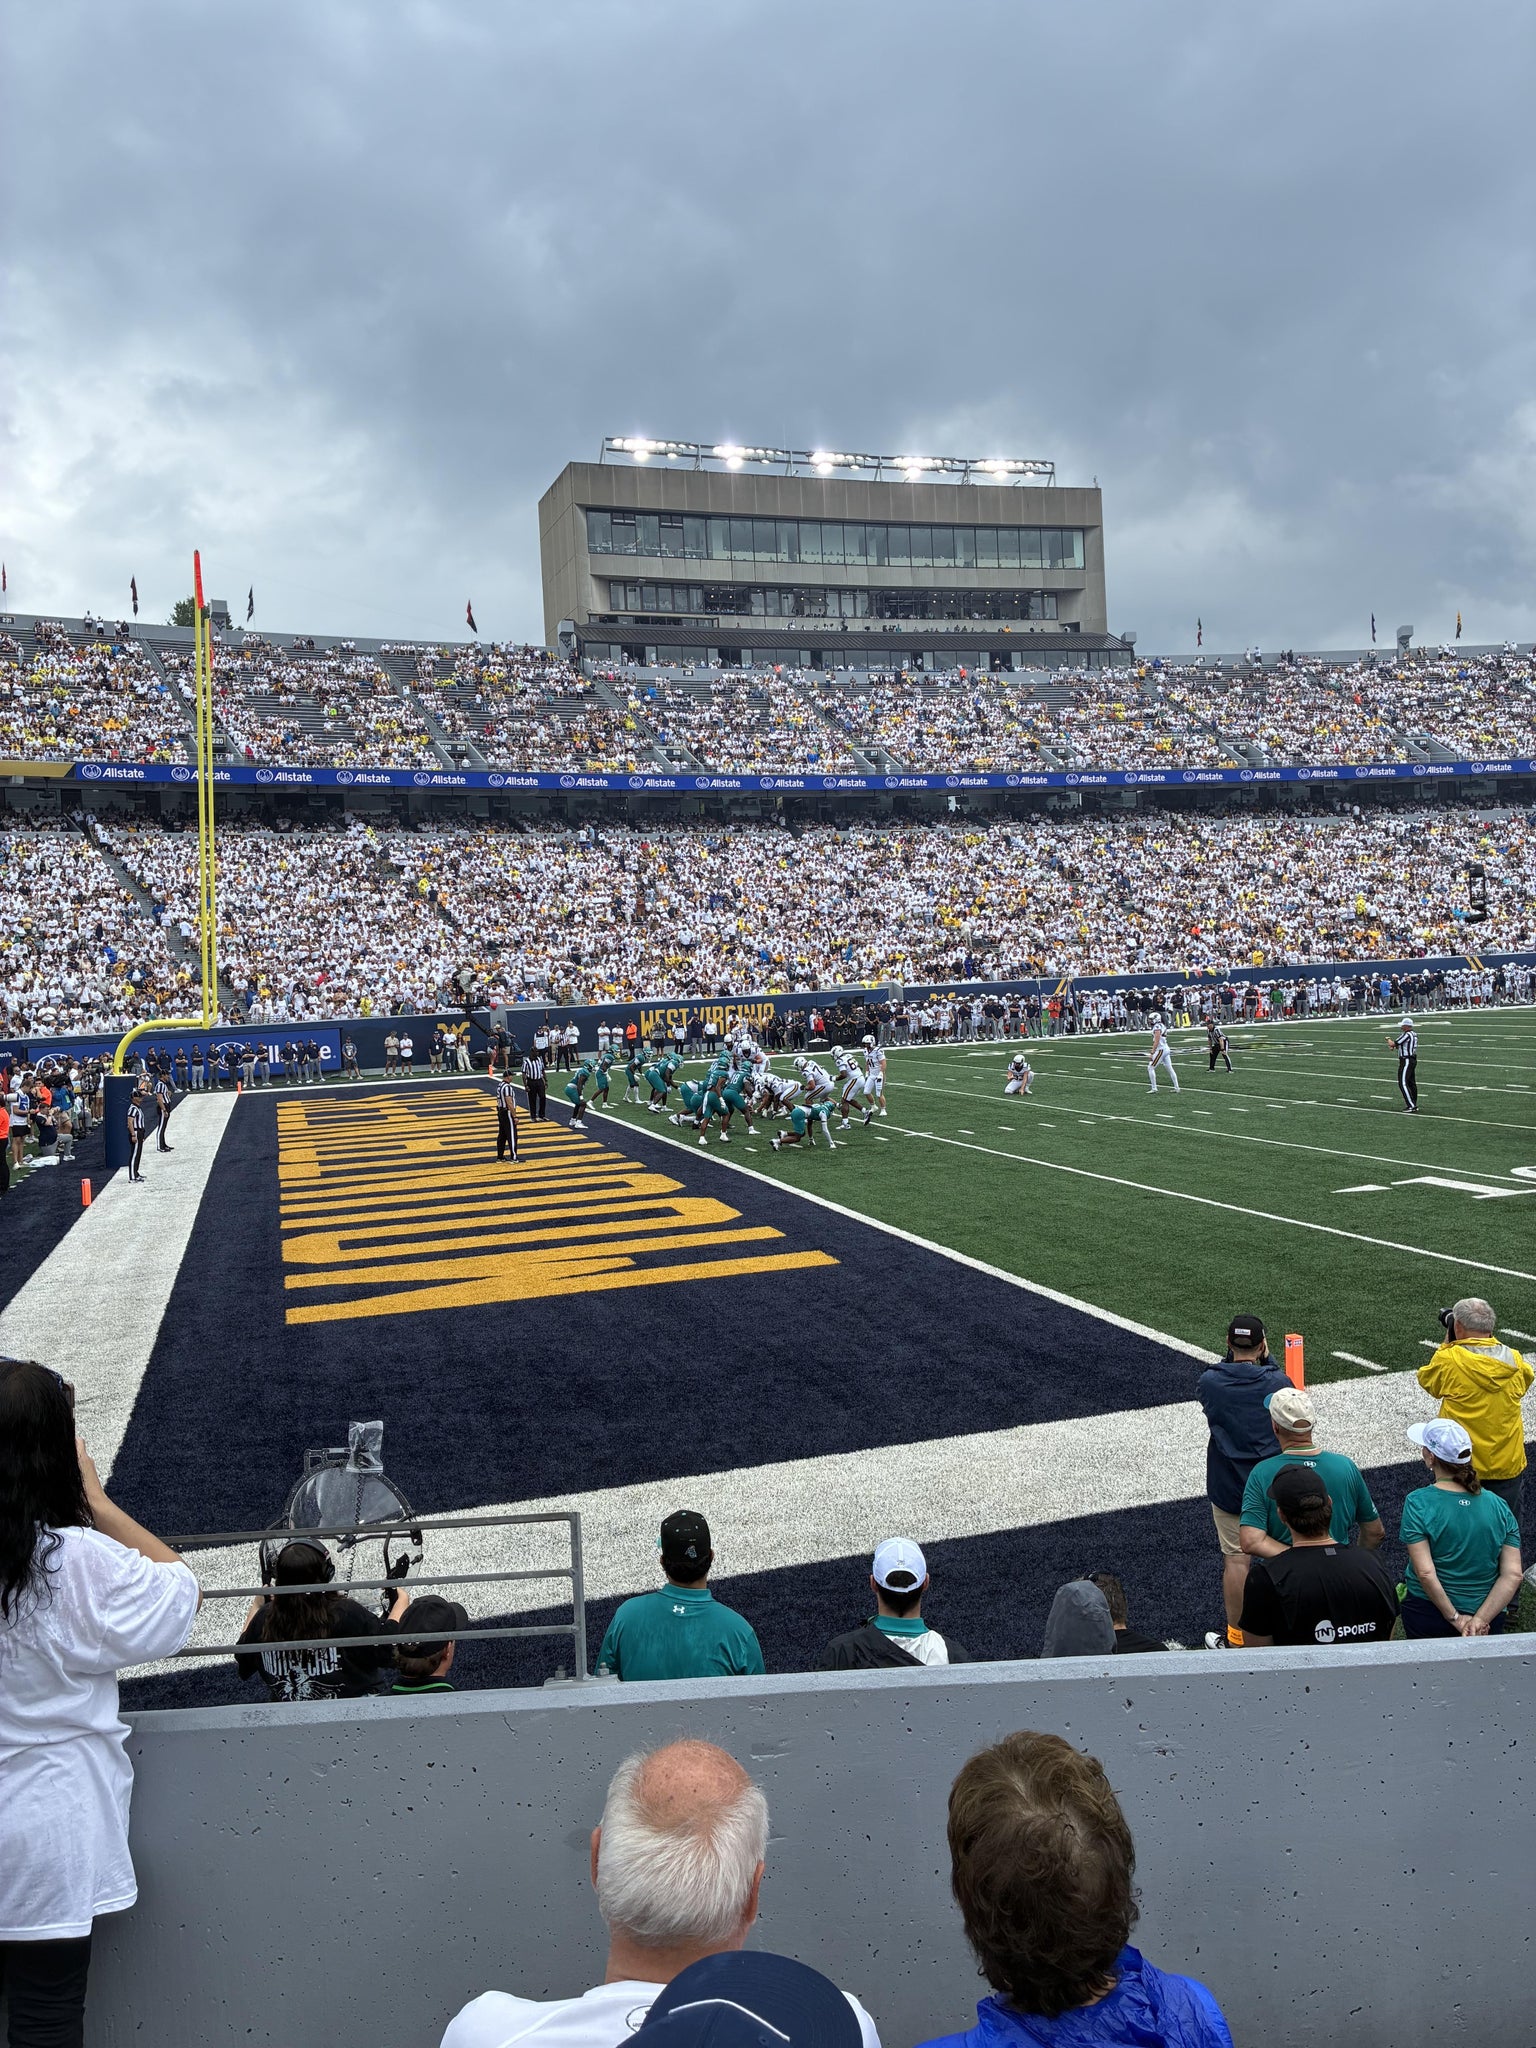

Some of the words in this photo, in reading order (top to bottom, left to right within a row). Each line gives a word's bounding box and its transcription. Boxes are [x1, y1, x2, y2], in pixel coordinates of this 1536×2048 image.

[1369, 767, 1396, 776] Allstate
[1427, 765, 1454, 774] Allstate
[1485, 763, 1513, 772] Allstate
[103, 768, 145, 778] Allstate
[275, 771, 313, 782] Allstate
[1138, 773, 1166, 782] Allstate
[1196, 772, 1224, 781] Allstate
[1254, 771, 1281, 780] Allstate
[1311, 769, 1339, 778] Allstate
[354, 773, 391, 784] Allstate
[431, 774, 466, 785] Allstate
[505, 776, 539, 786] Allstate
[576, 777, 609, 787] Allstate
[644, 778, 676, 788] Allstate
[710, 778, 741, 788] Allstate
[775, 778, 805, 788] Allstate
[837, 778, 867, 788] Allstate
[899, 778, 928, 787] Allstate
[960, 777, 989, 786] Allstate
[1020, 776, 1048, 785] Allstate
[1079, 775, 1108, 783] Allstate
[812, 1065, 823, 1075] 7
[1337, 1622, 1377, 1638] SPORTS
